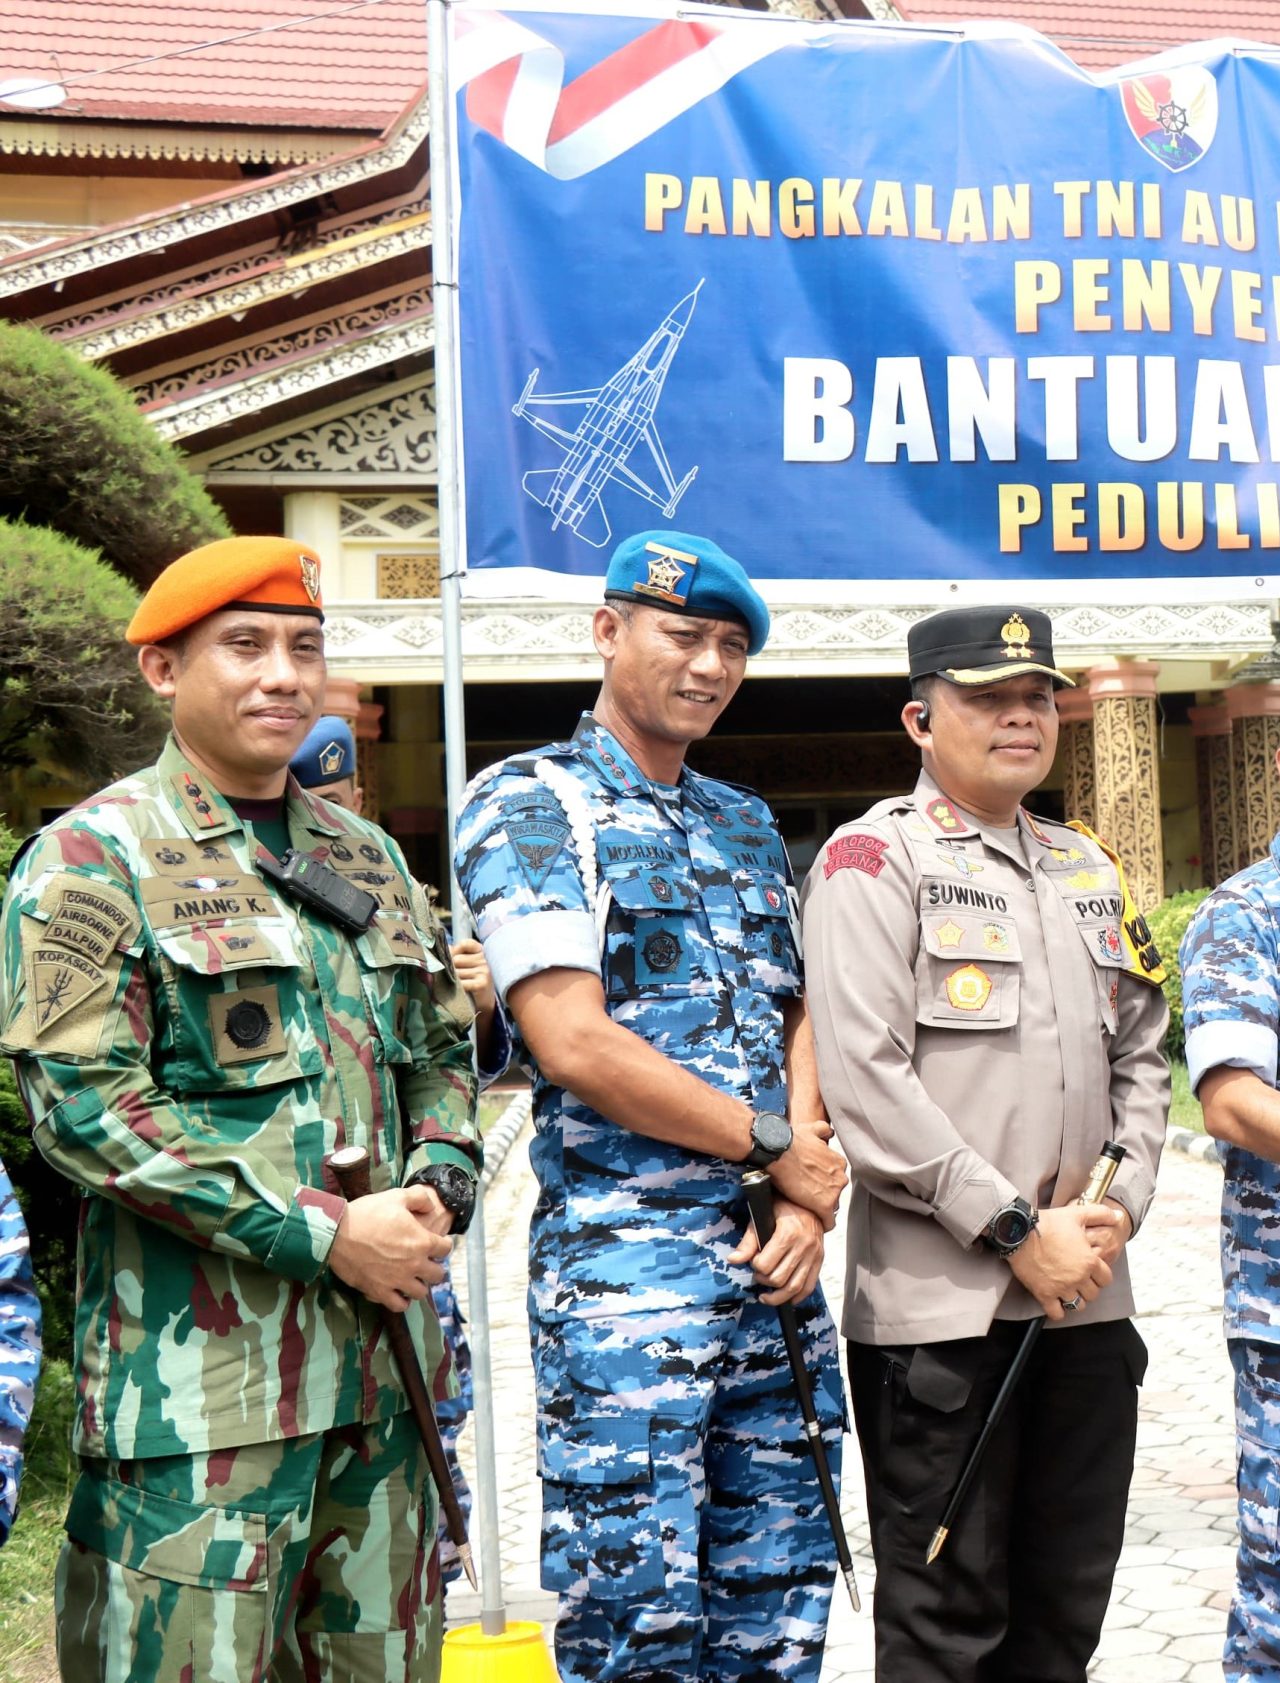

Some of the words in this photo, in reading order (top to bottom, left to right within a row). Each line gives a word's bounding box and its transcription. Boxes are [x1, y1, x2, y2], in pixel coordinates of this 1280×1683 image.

[645, 172, 1032, 243] PANGKALAN
[1053, 180, 1162, 239] TNI
[1181, 189, 1256, 252] AU
[731, 851, 760, 866] TNI
[830, 836, 883, 855] PELOPOR
[66, 893, 127, 927] COMMANDOS
[174, 897, 241, 920] ANANG
[246, 897, 268, 913] K.
[928, 880, 1008, 914] SUWINTO
[60, 909, 116, 941] AIRBORNE
[53, 926, 104, 957] DALPUR
[38, 951, 104, 981] KOPASGAT
